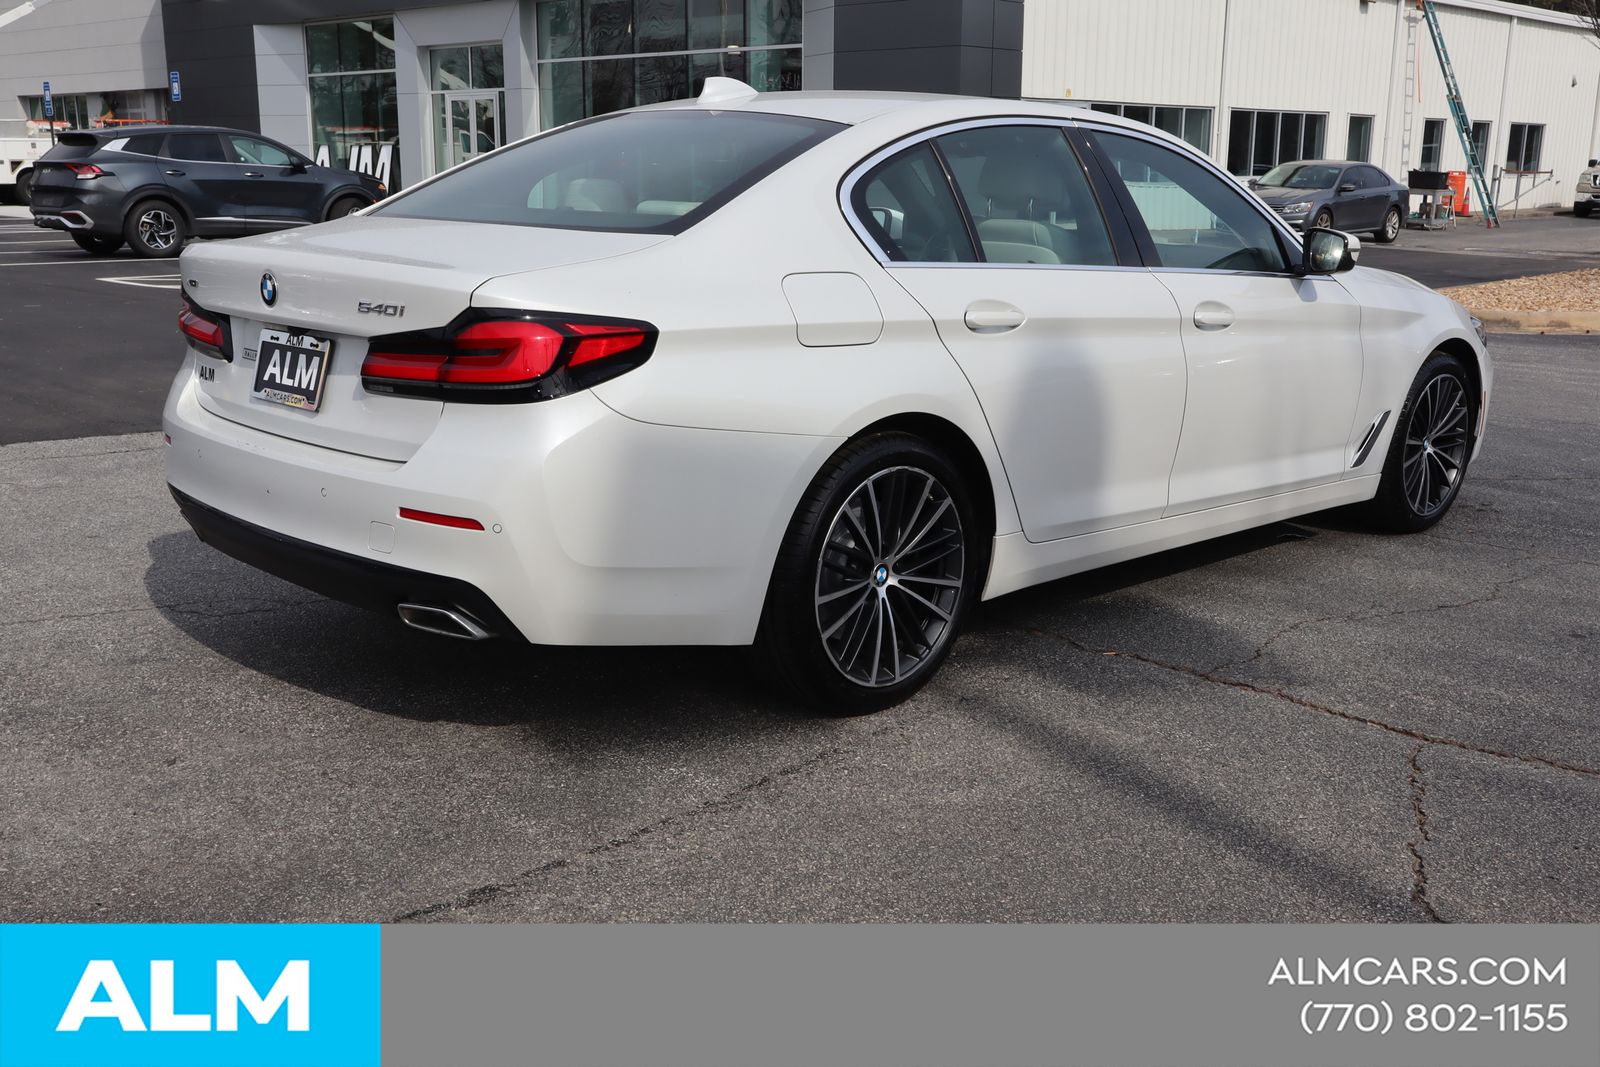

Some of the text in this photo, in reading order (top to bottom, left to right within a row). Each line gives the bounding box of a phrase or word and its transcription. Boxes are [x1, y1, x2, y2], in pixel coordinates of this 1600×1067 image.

[358, 302, 405, 317] 540i
[286, 335, 304, 347] ALM
[200, 366, 215, 382] ALM
[263, 349, 320, 391] ALM
